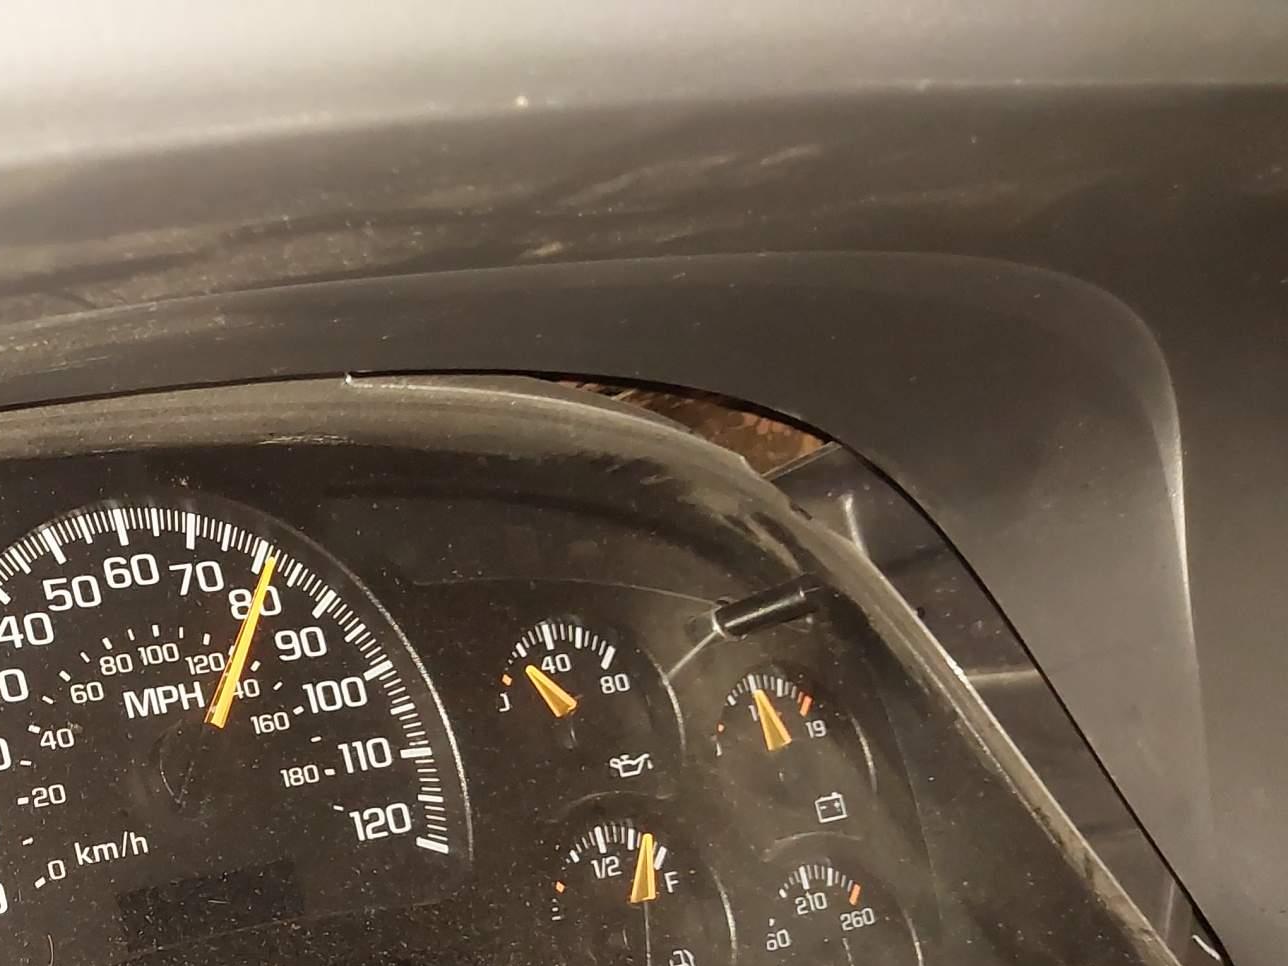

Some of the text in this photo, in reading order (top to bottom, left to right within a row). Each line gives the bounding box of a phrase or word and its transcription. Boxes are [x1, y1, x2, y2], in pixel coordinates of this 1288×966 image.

[103, 553, 160, 589] 60
[168, 560, 225, 596] 70
[42, 575, 102, 612] 50
[228, 585, 282, 621] 80
[137, 643, 180, 666] 100
[274, 626, 327, 661] 90
[99, 653, 134, 676] 80
[184, 652, 227, 676] 120
[541, 653, 572, 674] 40
[70, 681, 105, 704] 60
[301, 676, 369, 714] 100
[600, 673, 631, 694] 80
[122, 681, 205, 719] MPH
[250, 711, 290, 735] 160
[805, 719, 827, 738] 19
[40, 728, 75, 750] 40
[337, 737, 393, 774] 110
[280, 764, 320, 788] 180
[31, 784, 66, 808] 20
[349, 802, 412, 841] 120
[74, 831, 149, 866] km/h
[47, 859, 66, 880] 0
[590, 855, 622, 879] 1/2
[664, 871, 679, 893] F
[794, 891, 828, 915] 210
[839, 907, 876, 931] 260
